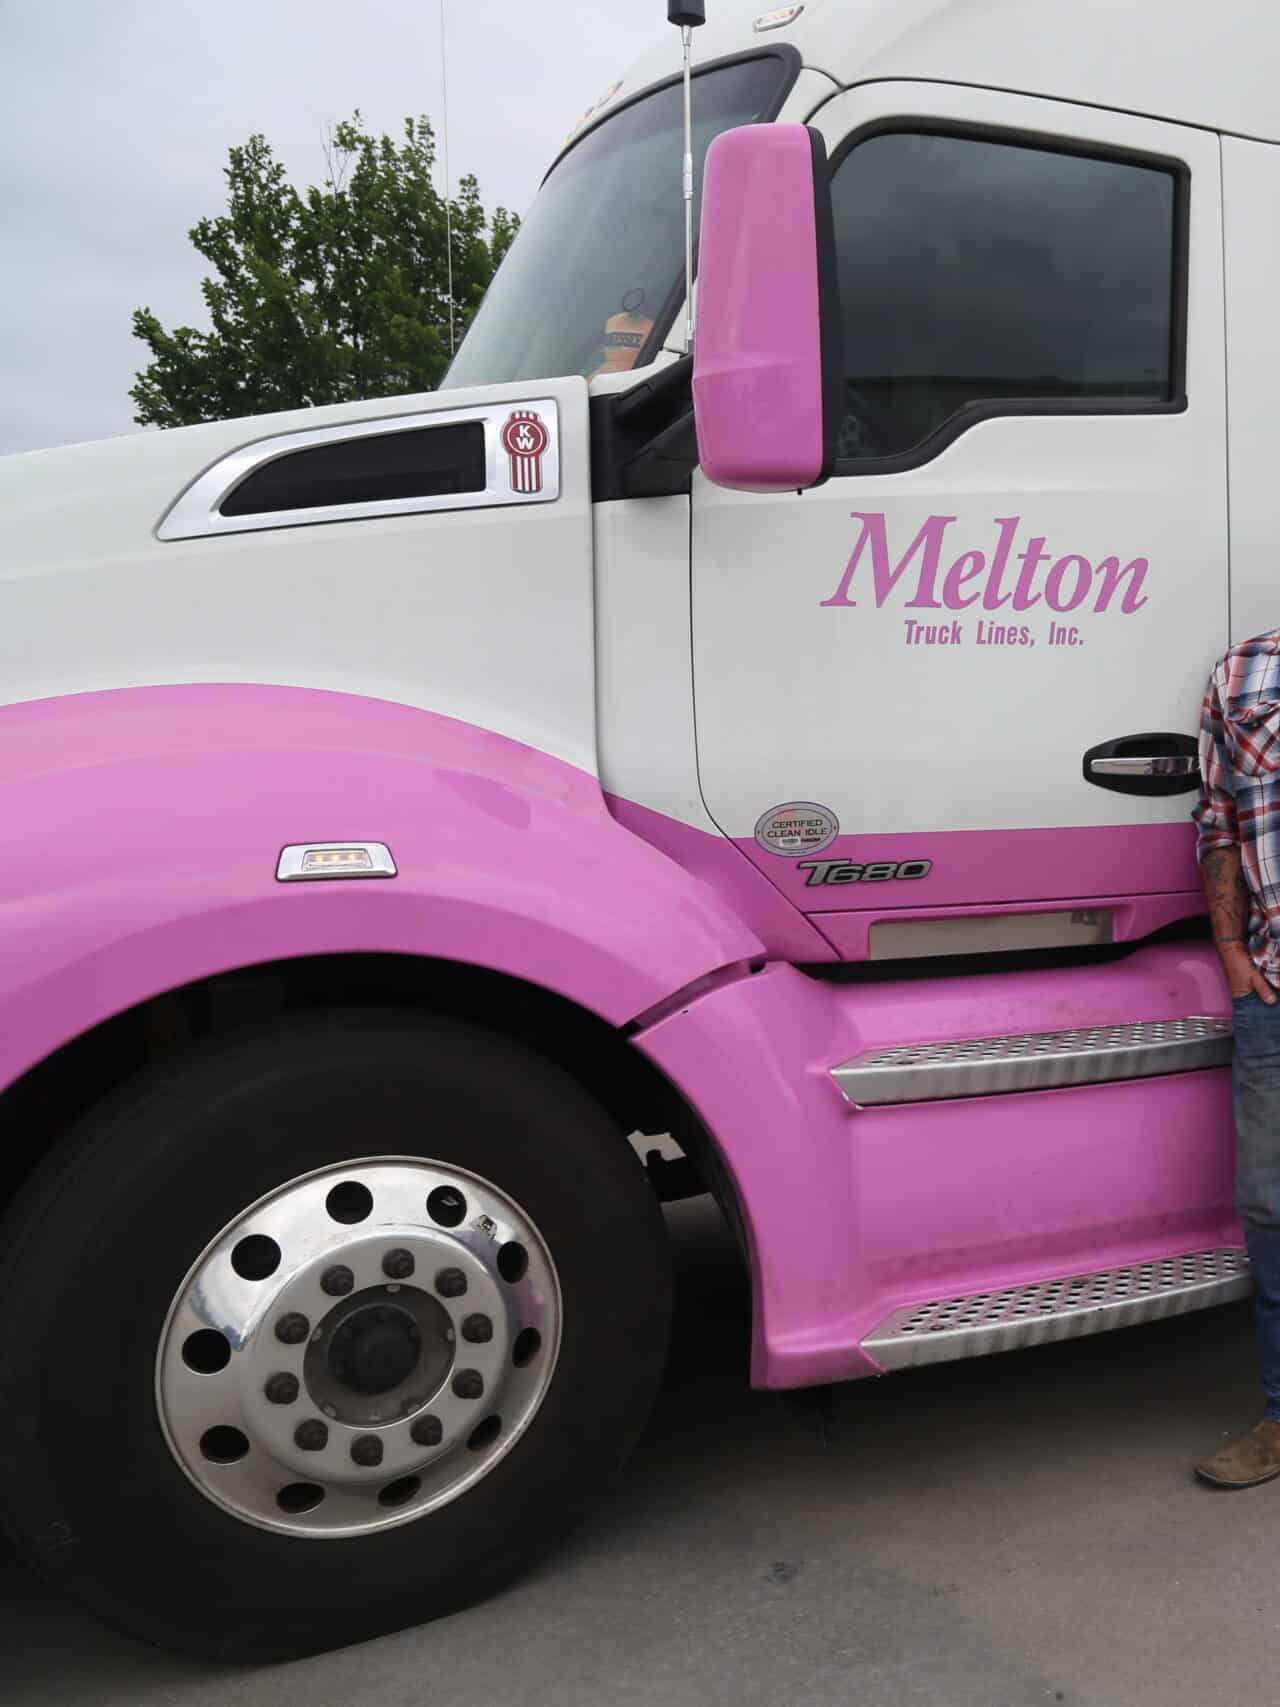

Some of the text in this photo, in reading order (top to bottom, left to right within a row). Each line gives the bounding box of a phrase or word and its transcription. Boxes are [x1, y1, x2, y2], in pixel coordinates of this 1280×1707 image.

[819, 512, 1150, 614] Melton
[904, 619, 1084, 648] Truck Lines, Inc.
[768, 827, 828, 839] CLEAN IDLE
[772, 819, 823, 830] CERTIFIED
[799, 858, 933, 887] T680
